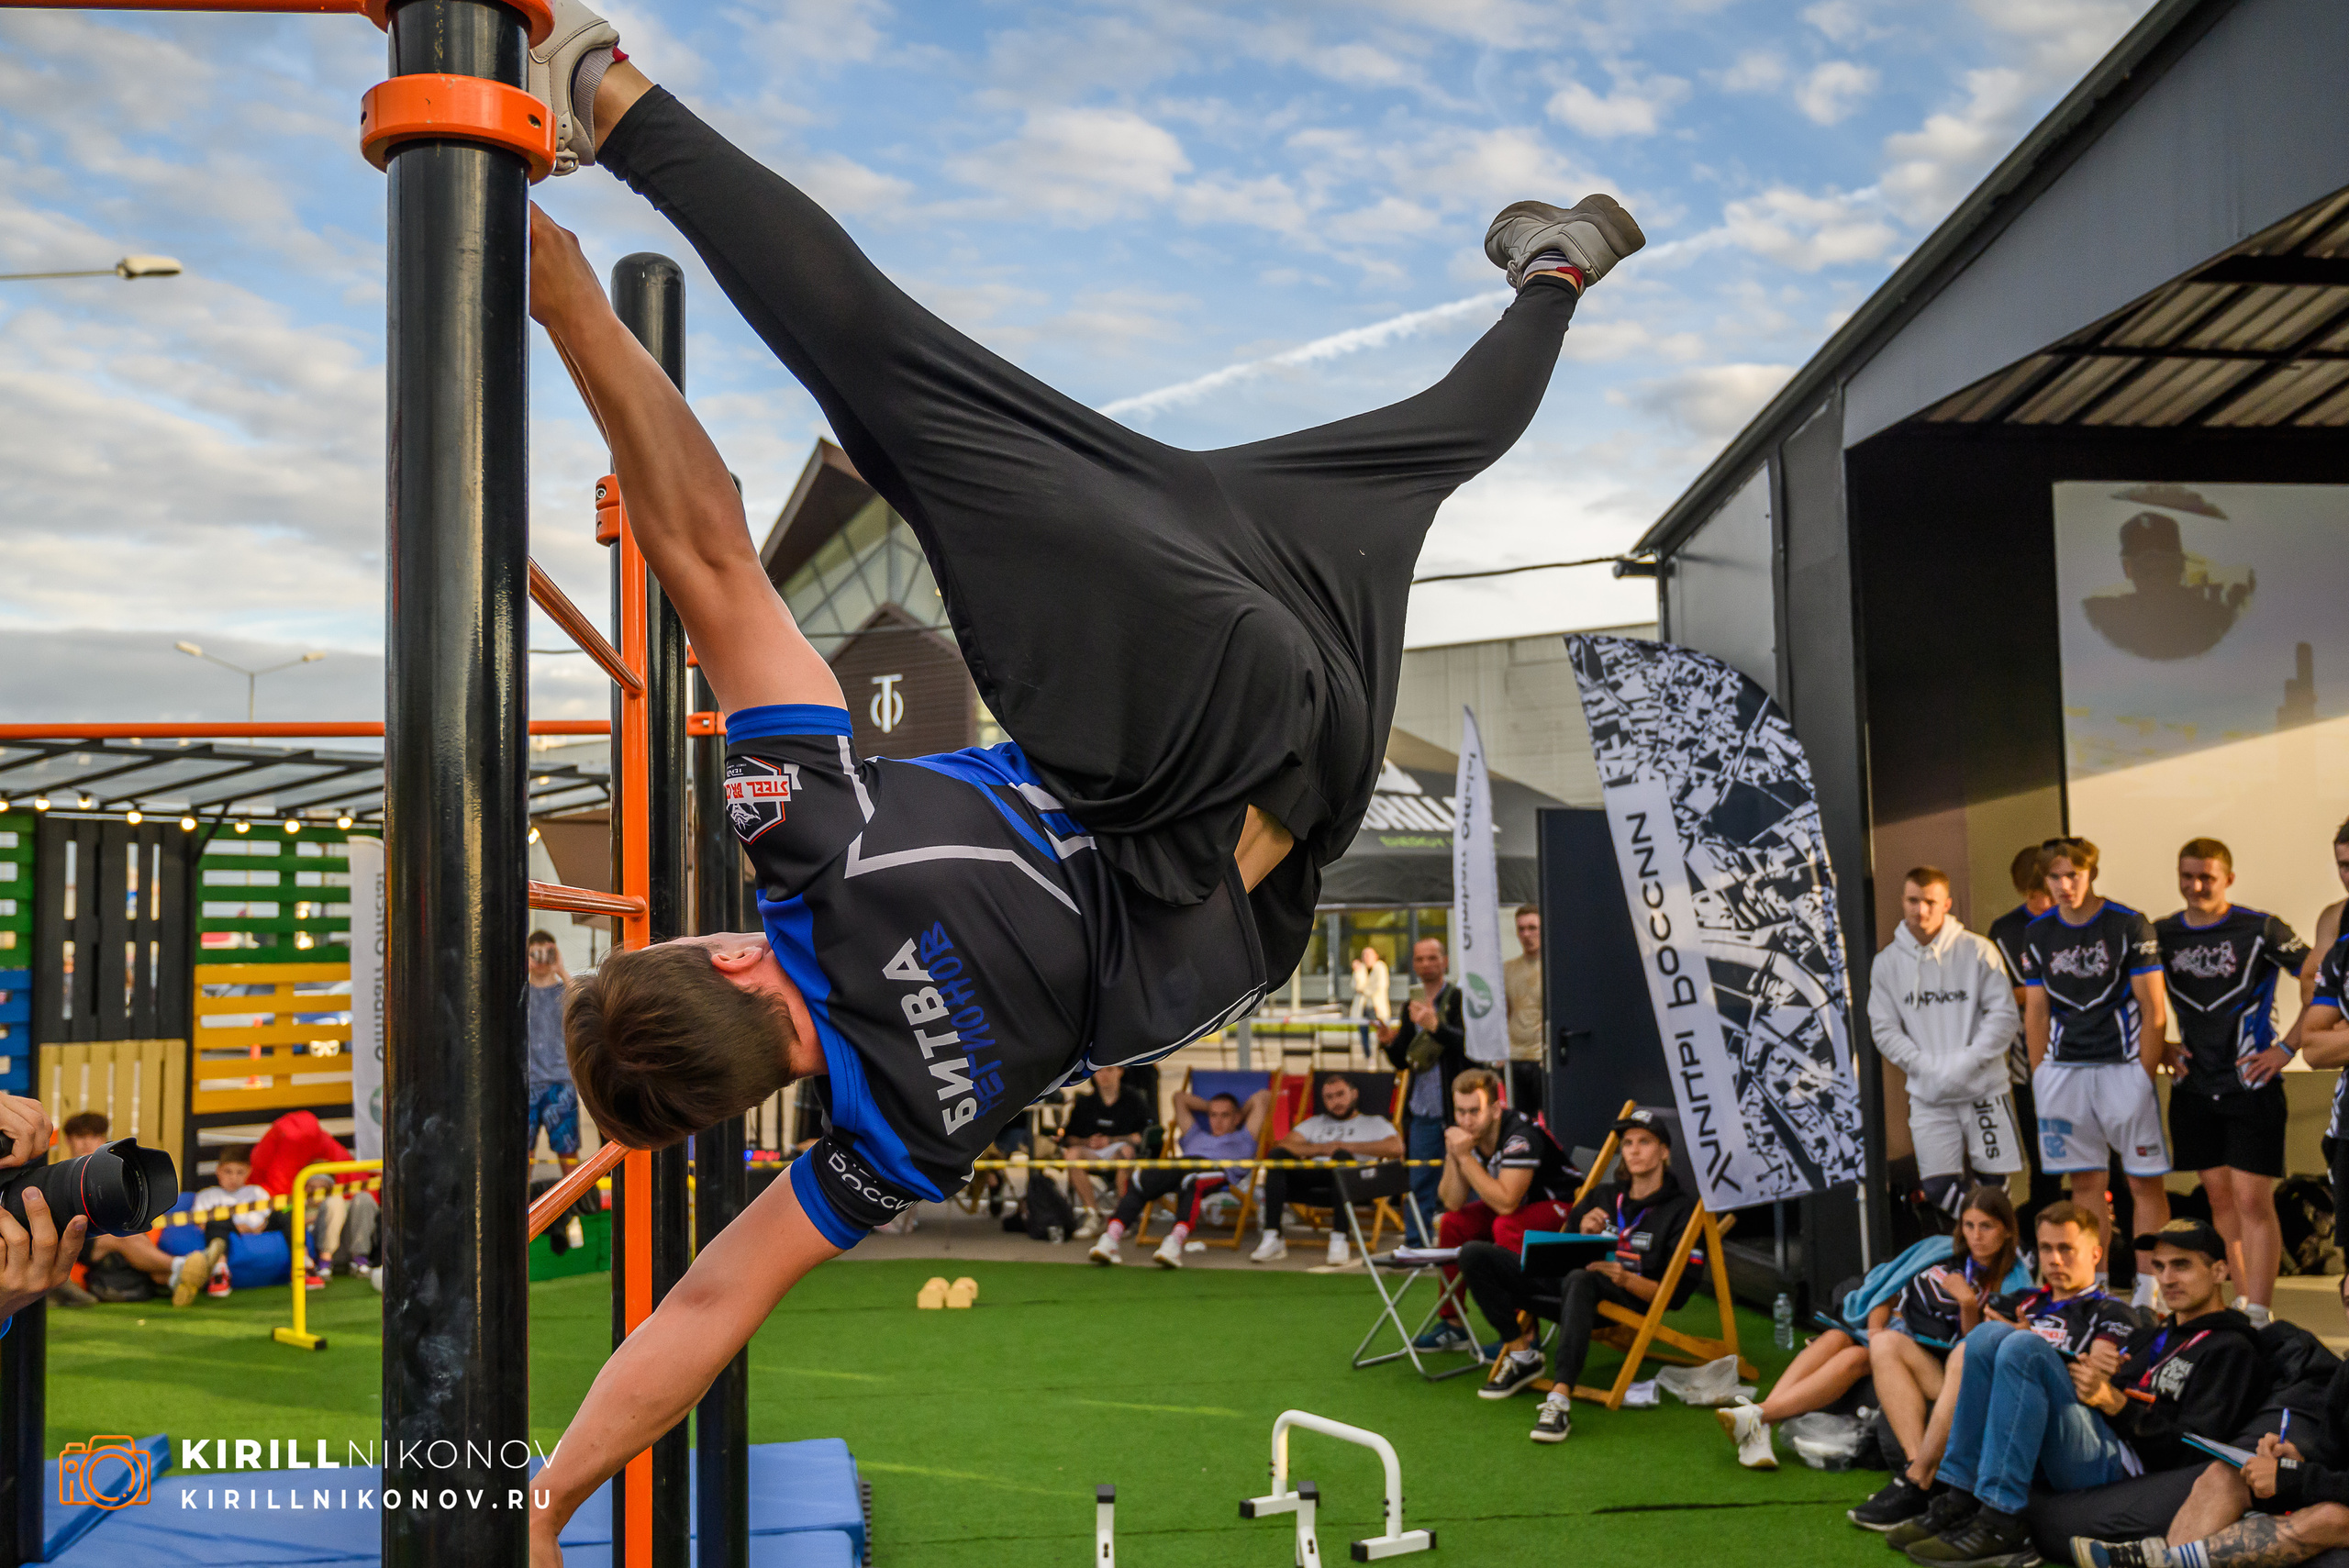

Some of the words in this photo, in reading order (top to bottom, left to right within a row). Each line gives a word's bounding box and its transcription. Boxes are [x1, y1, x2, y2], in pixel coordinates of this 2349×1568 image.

[746, 781, 789, 797] STEEL
[882, 937, 978, 1136] БИТВА
[919, 920, 1005, 1120] РЕГИОНОВ
[1973, 1099, 2000, 1160] didas
[828, 1151, 918, 1210] РОССИ
